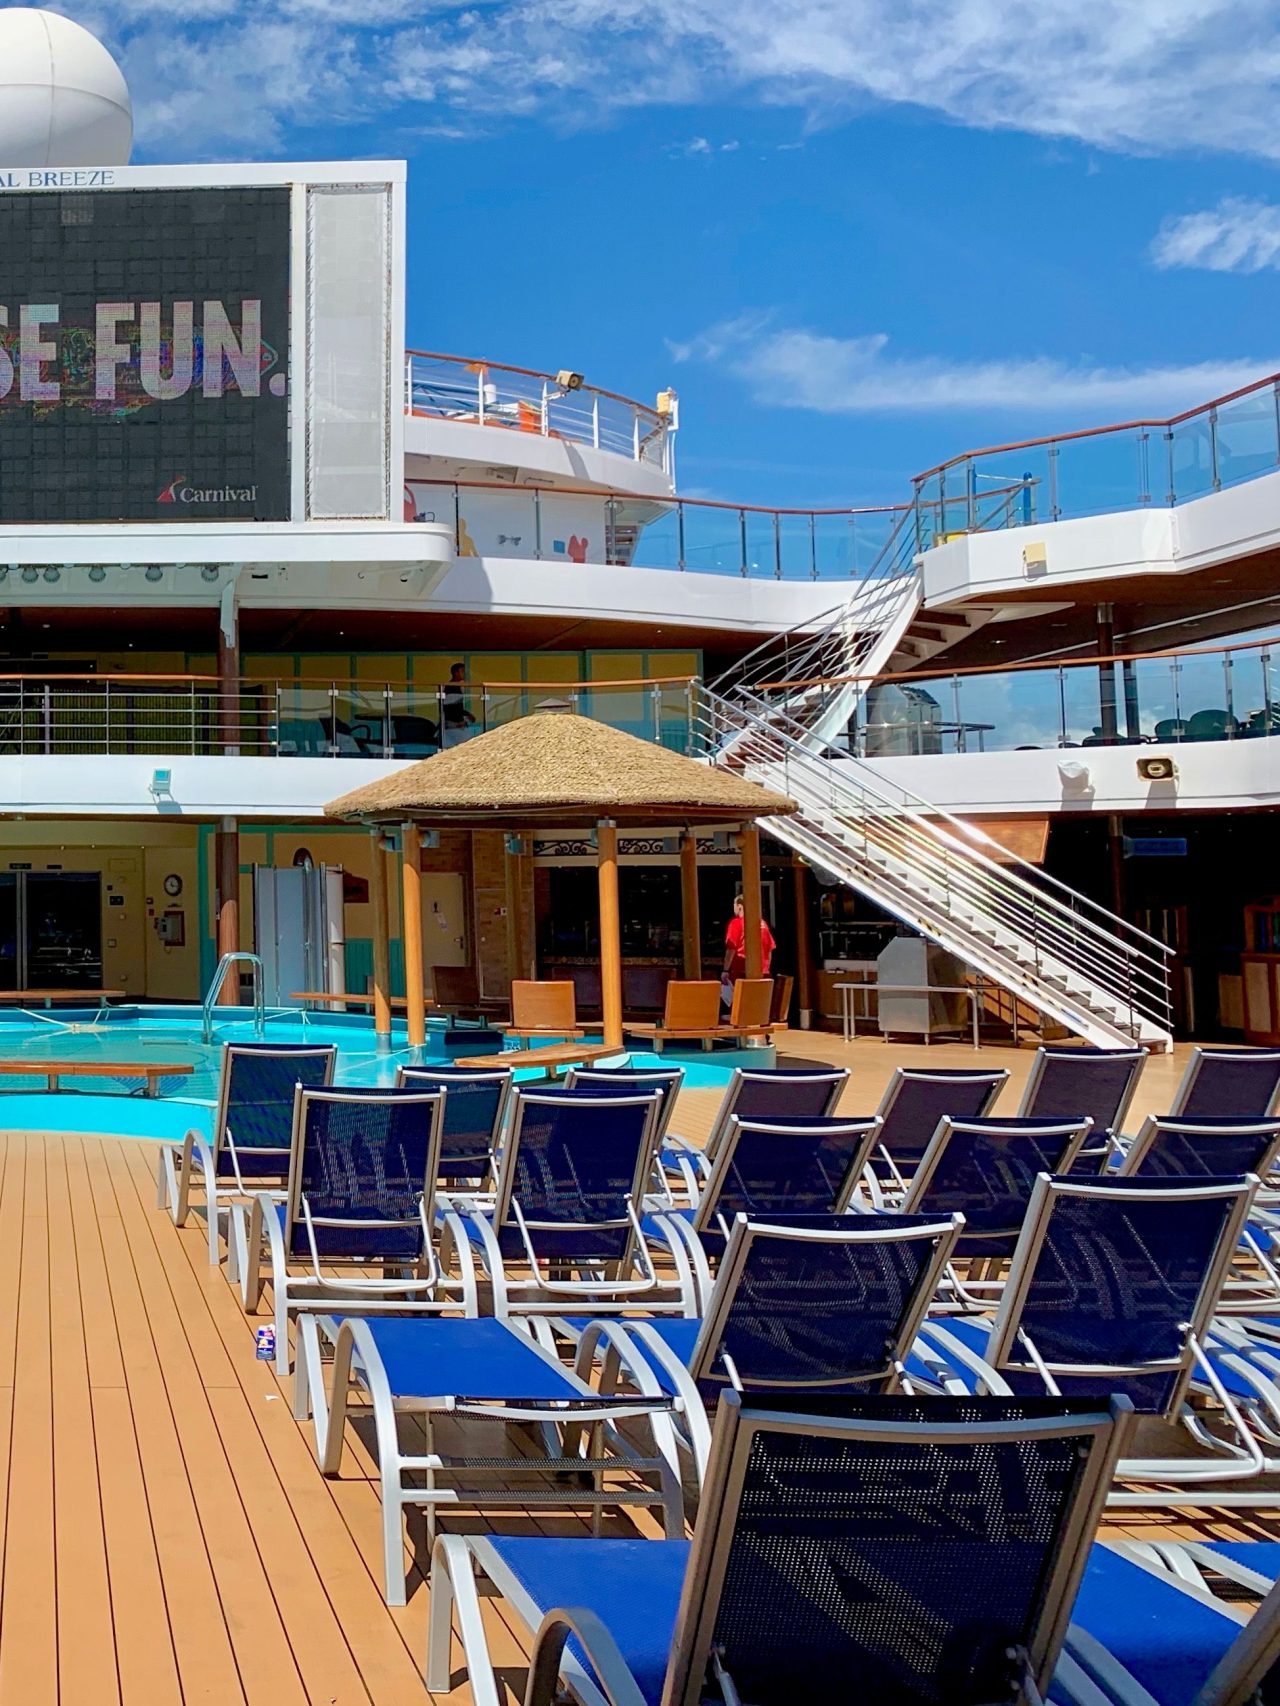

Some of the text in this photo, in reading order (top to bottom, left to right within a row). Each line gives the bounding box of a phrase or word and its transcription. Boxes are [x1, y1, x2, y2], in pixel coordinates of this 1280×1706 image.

[28, 170, 115, 187] BREEZE
[95, 299, 286, 401] FUN.
[179, 485, 257, 503] Carnival
